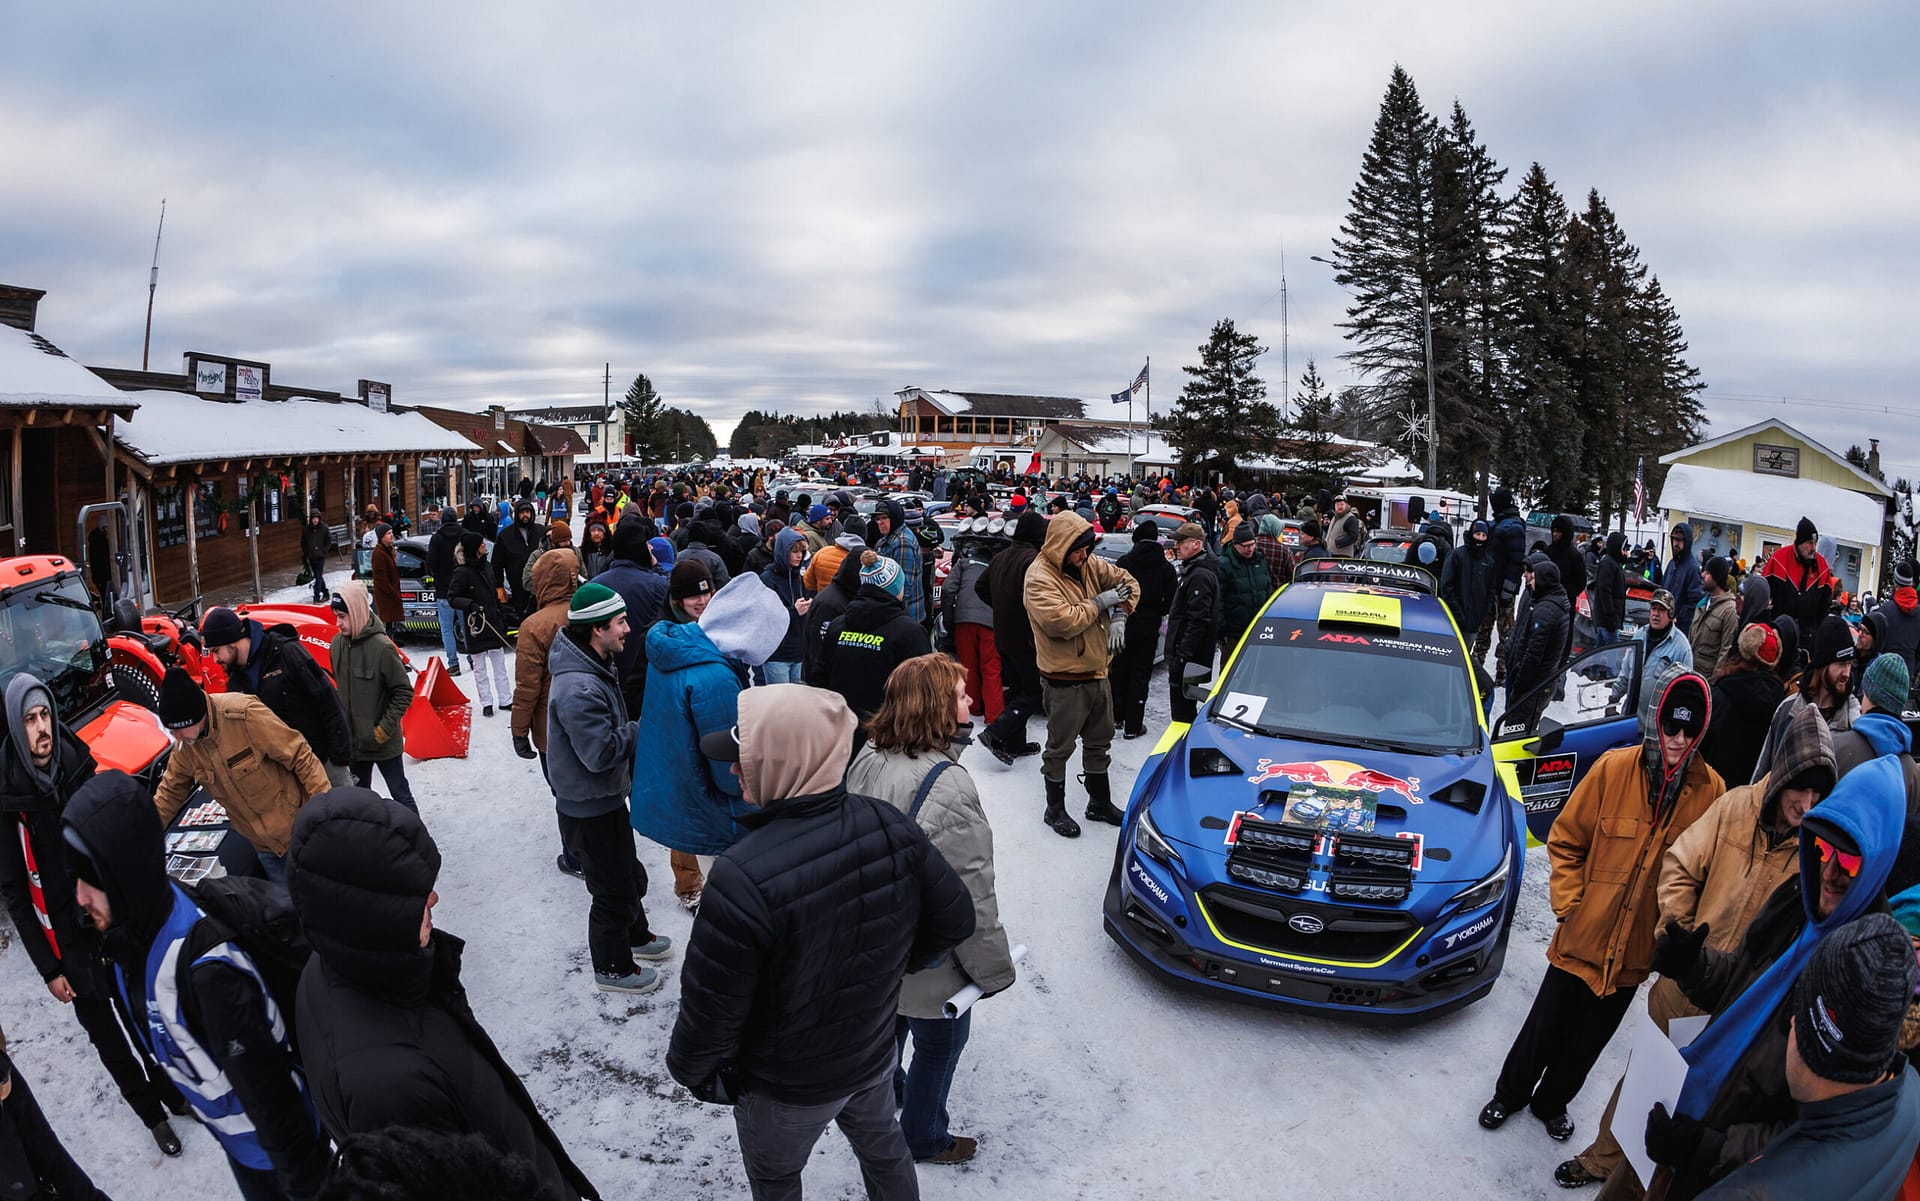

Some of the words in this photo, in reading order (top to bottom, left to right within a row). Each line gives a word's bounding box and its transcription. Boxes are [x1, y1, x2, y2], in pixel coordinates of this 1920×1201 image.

[1338, 563, 1420, 580] YOKOHAMA
[421, 592, 435, 602] 84
[1335, 609, 1387, 618] SUBARU
[837, 641, 881, 651] MOTORSPORTS
[838, 631, 884, 646] FERVOR
[1372, 638, 1422, 649] AMERICAN
[1424, 645, 1453, 654] RALLY
[1235, 704, 1249, 720] 2
[1537, 760, 1572, 773] ARA
[1139, 870, 1169, 904] YOKOHAMA
[1457, 915, 1494, 941] YOKOHAMA
[1260, 957, 1336, 975] VermontSportsCar
